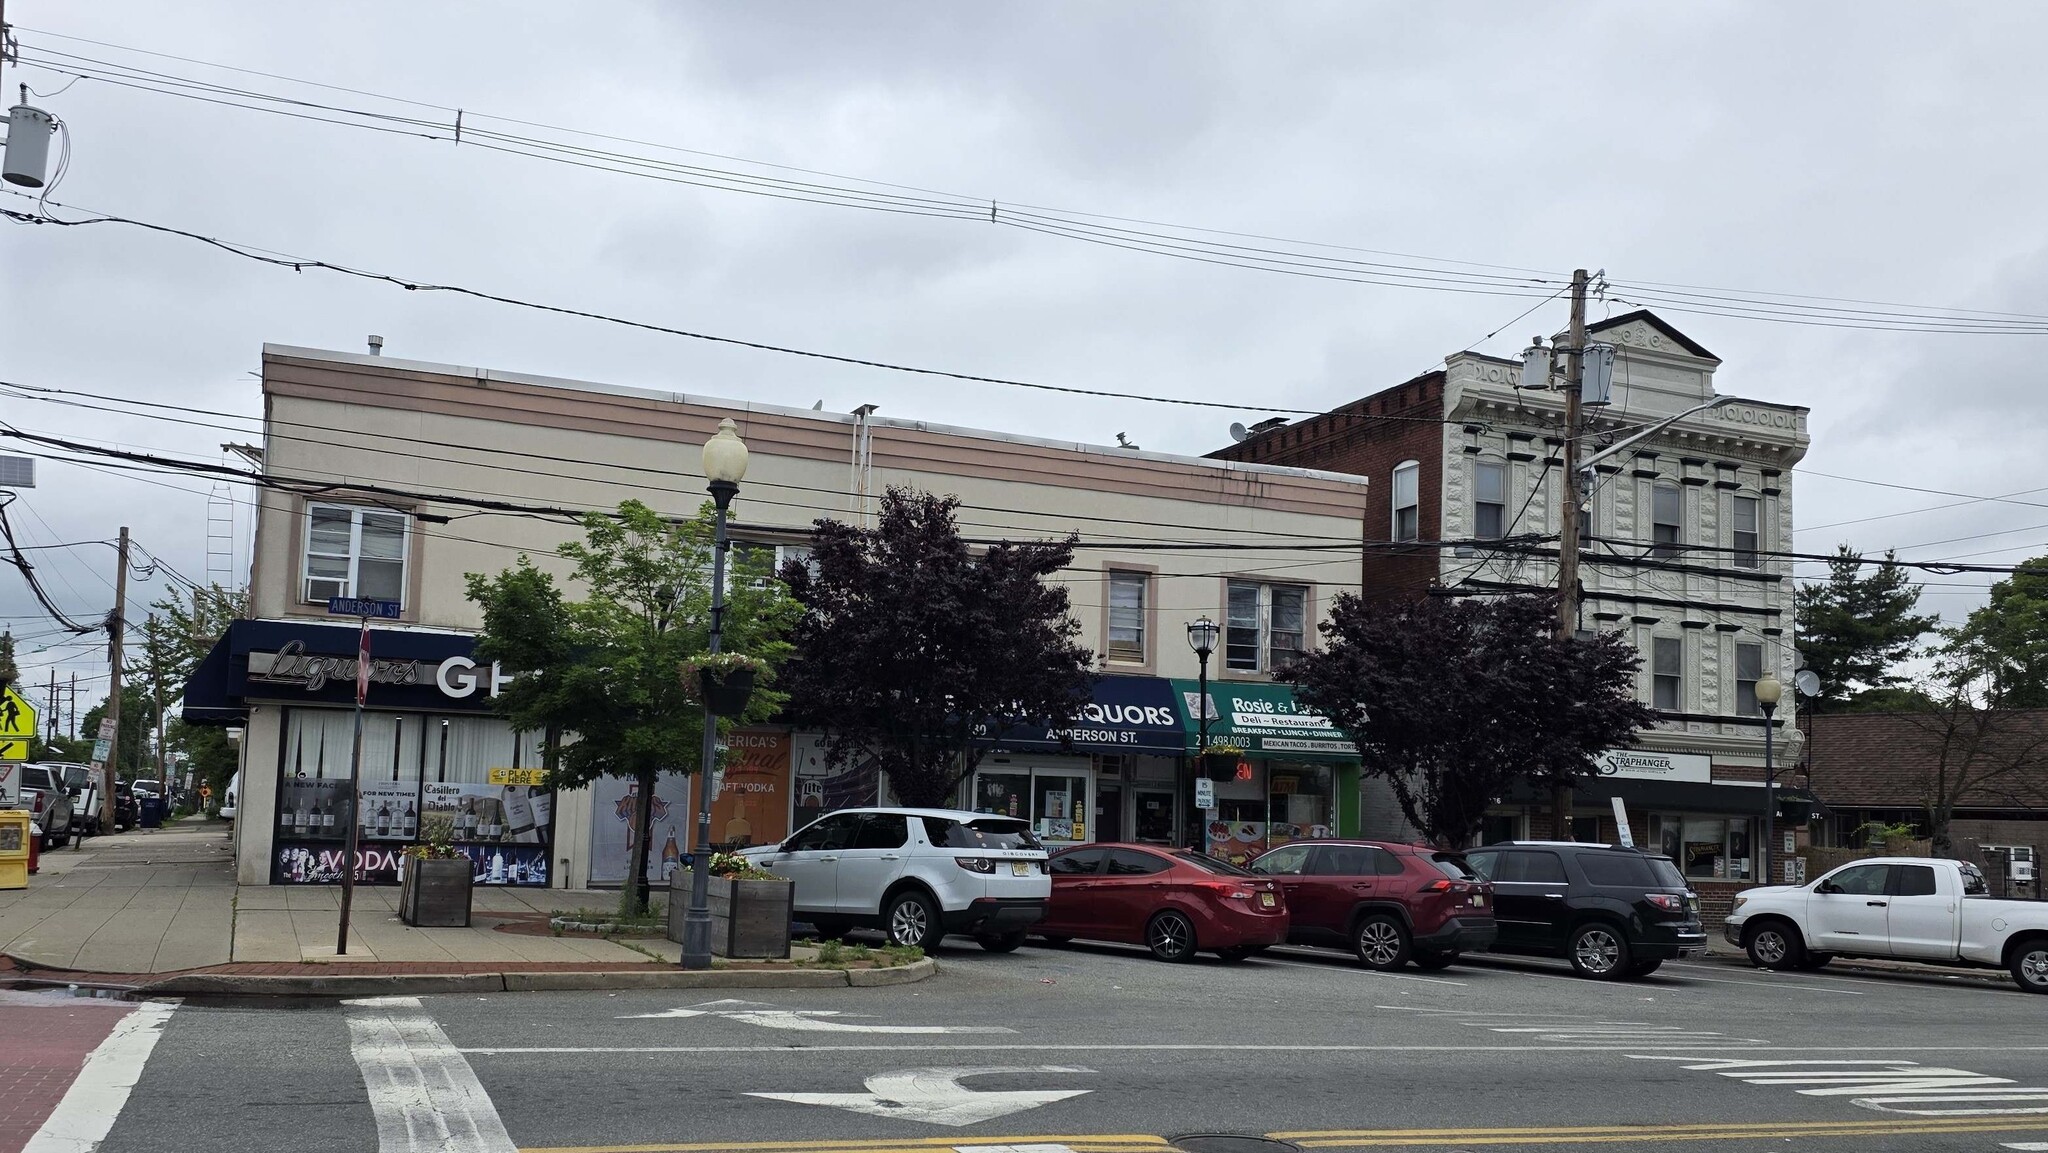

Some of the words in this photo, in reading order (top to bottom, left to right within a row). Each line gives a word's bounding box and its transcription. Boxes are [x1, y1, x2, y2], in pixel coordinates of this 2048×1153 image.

[331, 600, 383, 616] ANDERSON
[388, 604, 399, 617] ST
[1232, 698, 1274, 713] Rosie
[1277, 702, 1288, 714] &
[1241, 715, 1262, 725] Deli
[1120, 731, 1138, 744] ST.
[1231, 726, 1277, 736] BREAKFAST
[1281, 729, 1309, 737] LUNCH
[1312, 730, 1344, 739] DINNER
[715, 735, 778, 748] MERICA'S
[1195, 734, 1251, 748] 21.498.0003
[1263, 739, 1289, 748] MEXICAN
[1289, 740, 1307, 748] TACOS
[1310, 741, 1338, 750] BURRITOS
[1340, 743, 1357, 751] TORT
[1600, 755, 1675, 775] STRAPHANGER
[508, 770, 533, 778] PLAY
[424, 783, 460, 795] Casillero
[803, 782, 822, 795] Lite
[427, 800, 455, 812] Diablo
